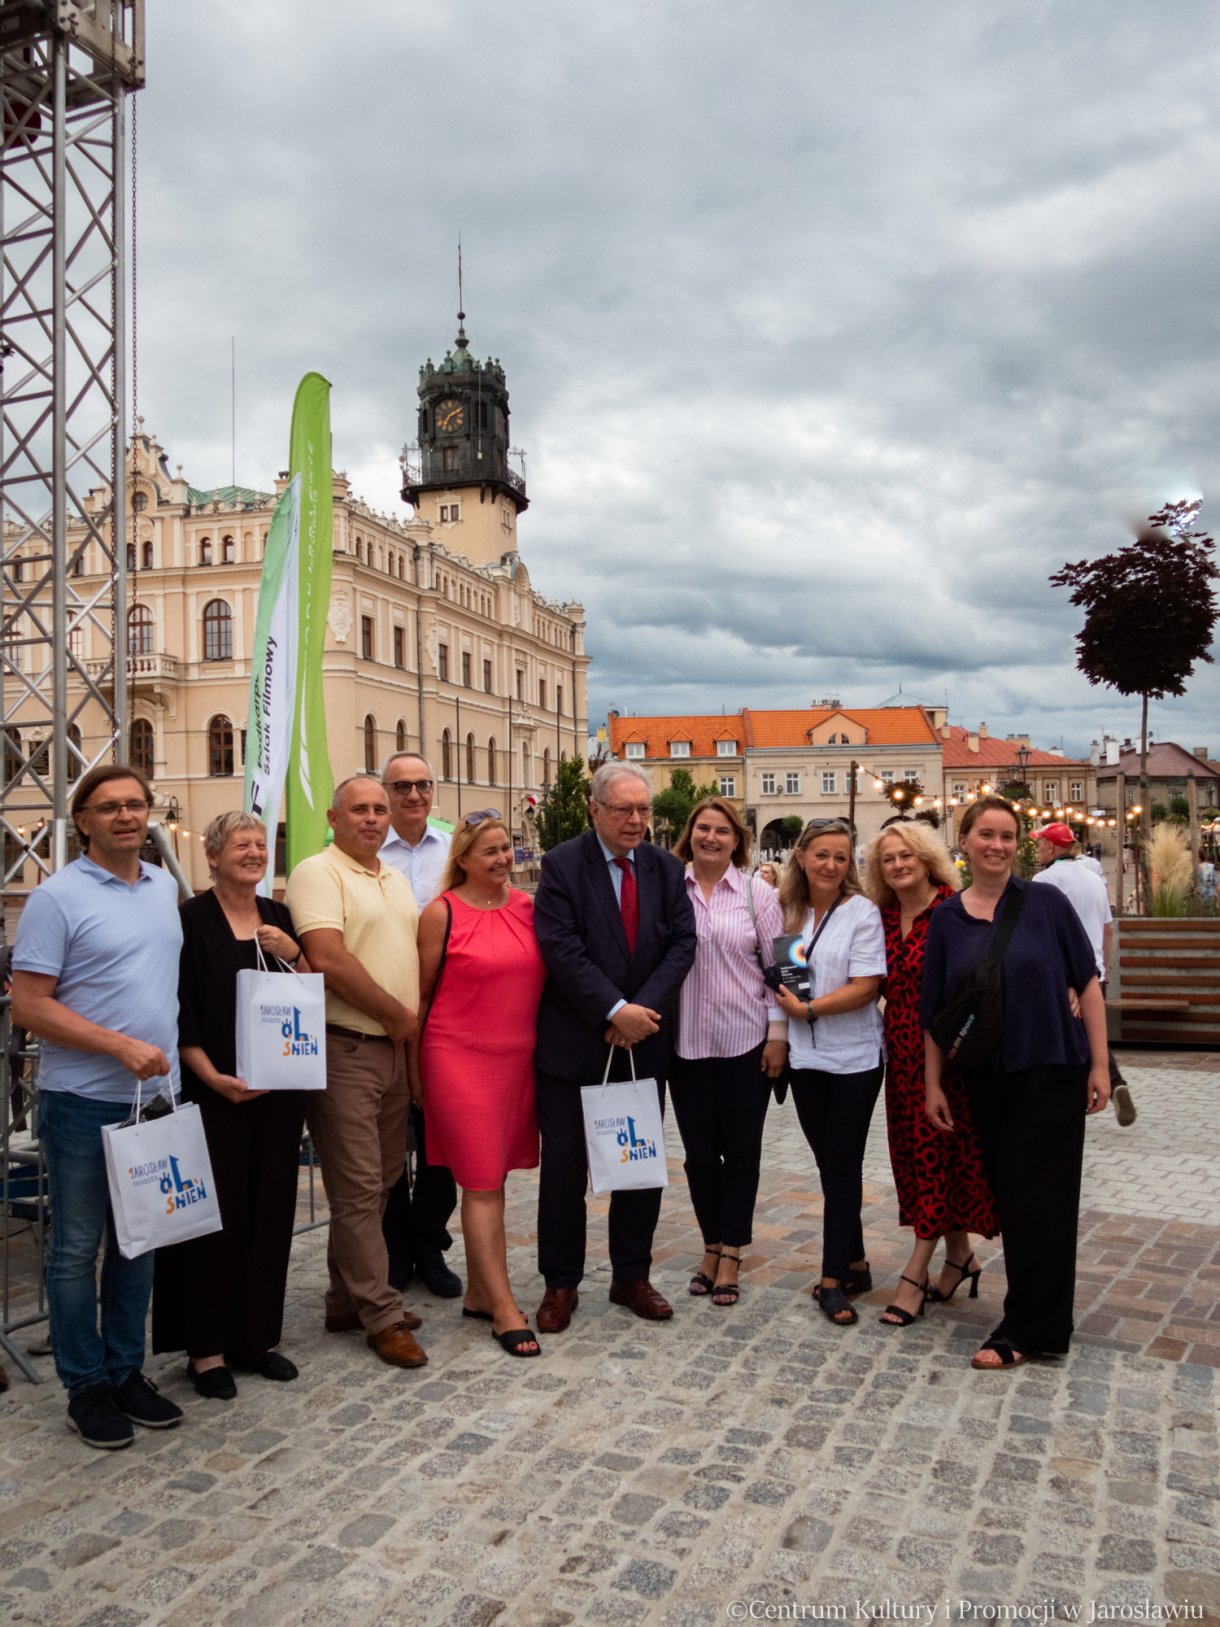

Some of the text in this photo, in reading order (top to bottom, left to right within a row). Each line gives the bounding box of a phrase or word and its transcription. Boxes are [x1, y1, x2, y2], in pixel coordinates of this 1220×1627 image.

[262, 636, 278, 776] Szlak Filmowy
[128, 1157, 168, 1179] JAROSŁAW
[132, 1175, 158, 1187] miasto
